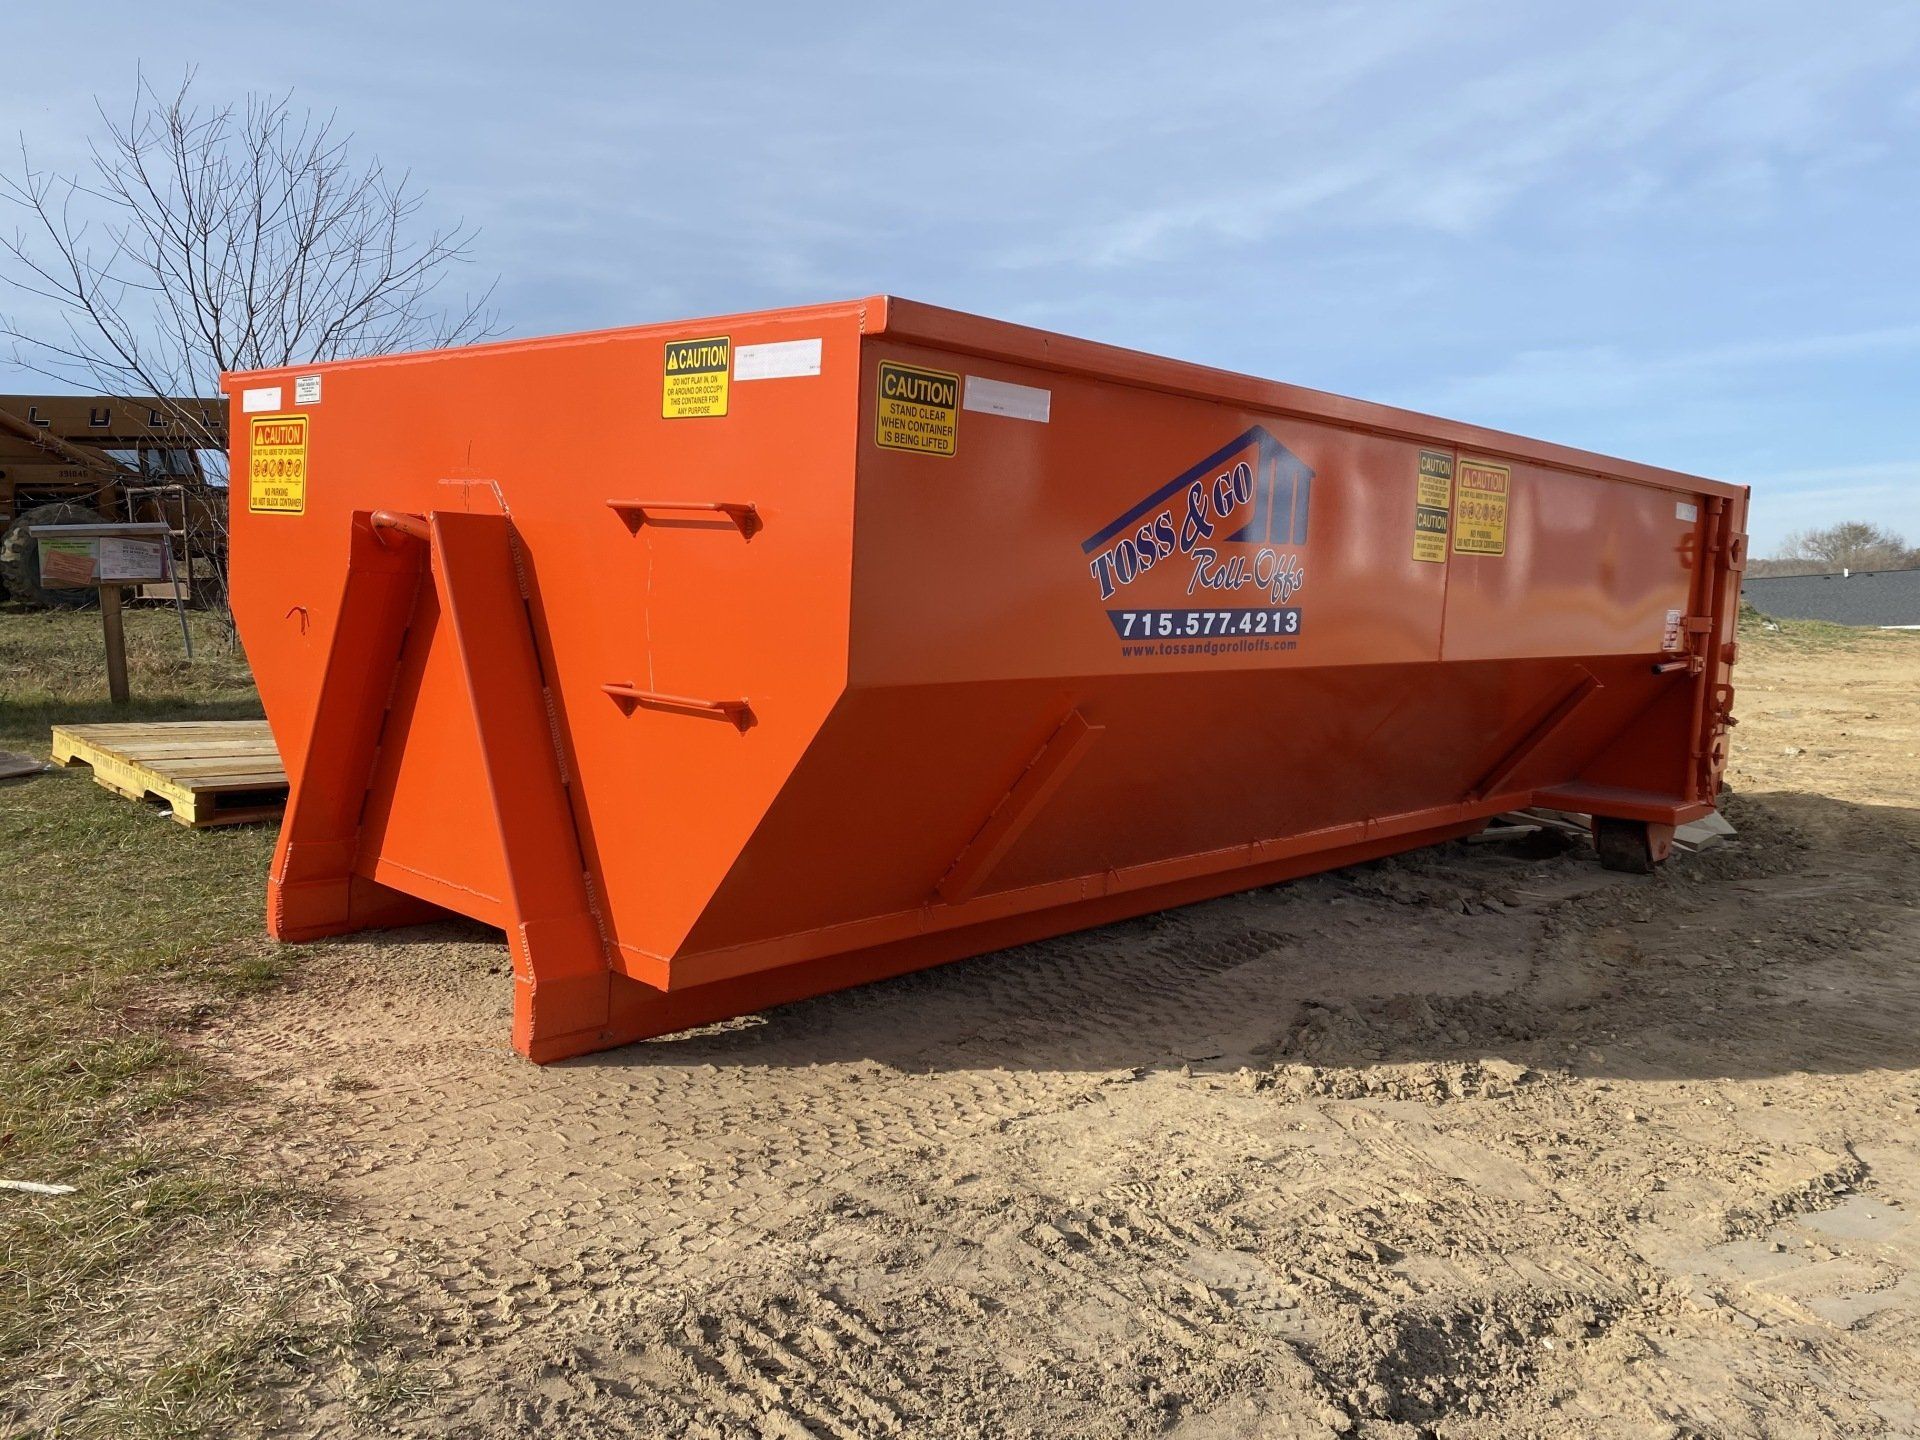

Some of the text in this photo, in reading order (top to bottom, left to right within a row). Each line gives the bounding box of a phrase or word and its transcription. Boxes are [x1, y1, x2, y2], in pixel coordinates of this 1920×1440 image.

[679, 346, 727, 369] CAUTION
[681, 377, 690, 386] NOT
[885, 373, 954, 406] CAUTION
[681, 396, 708, 405] CONTAINER
[709, 395, 719, 404] FOR
[688, 406, 710, 414] PURPOSE
[890, 403, 946, 421] STAND CLEAR
[264, 425, 301, 444] CAUTION
[881, 415, 953, 437] WHEN CONTAINER
[884, 431, 949, 450] IS BEING LIFTED
[1421, 456, 1451, 475] CAUTION
[1472, 470, 1504, 492] CAUTION
[271, 488, 288, 497] PARKING
[1418, 512, 1446, 530] CAUTION
[1090, 461, 1254, 601] TOSS & GO
[1187, 548, 1304, 605] Roll-Offs
[1122, 611, 1298, 636] 715.577.4213
[1122, 639, 1297, 657] www.tossandgorolloffs.com
